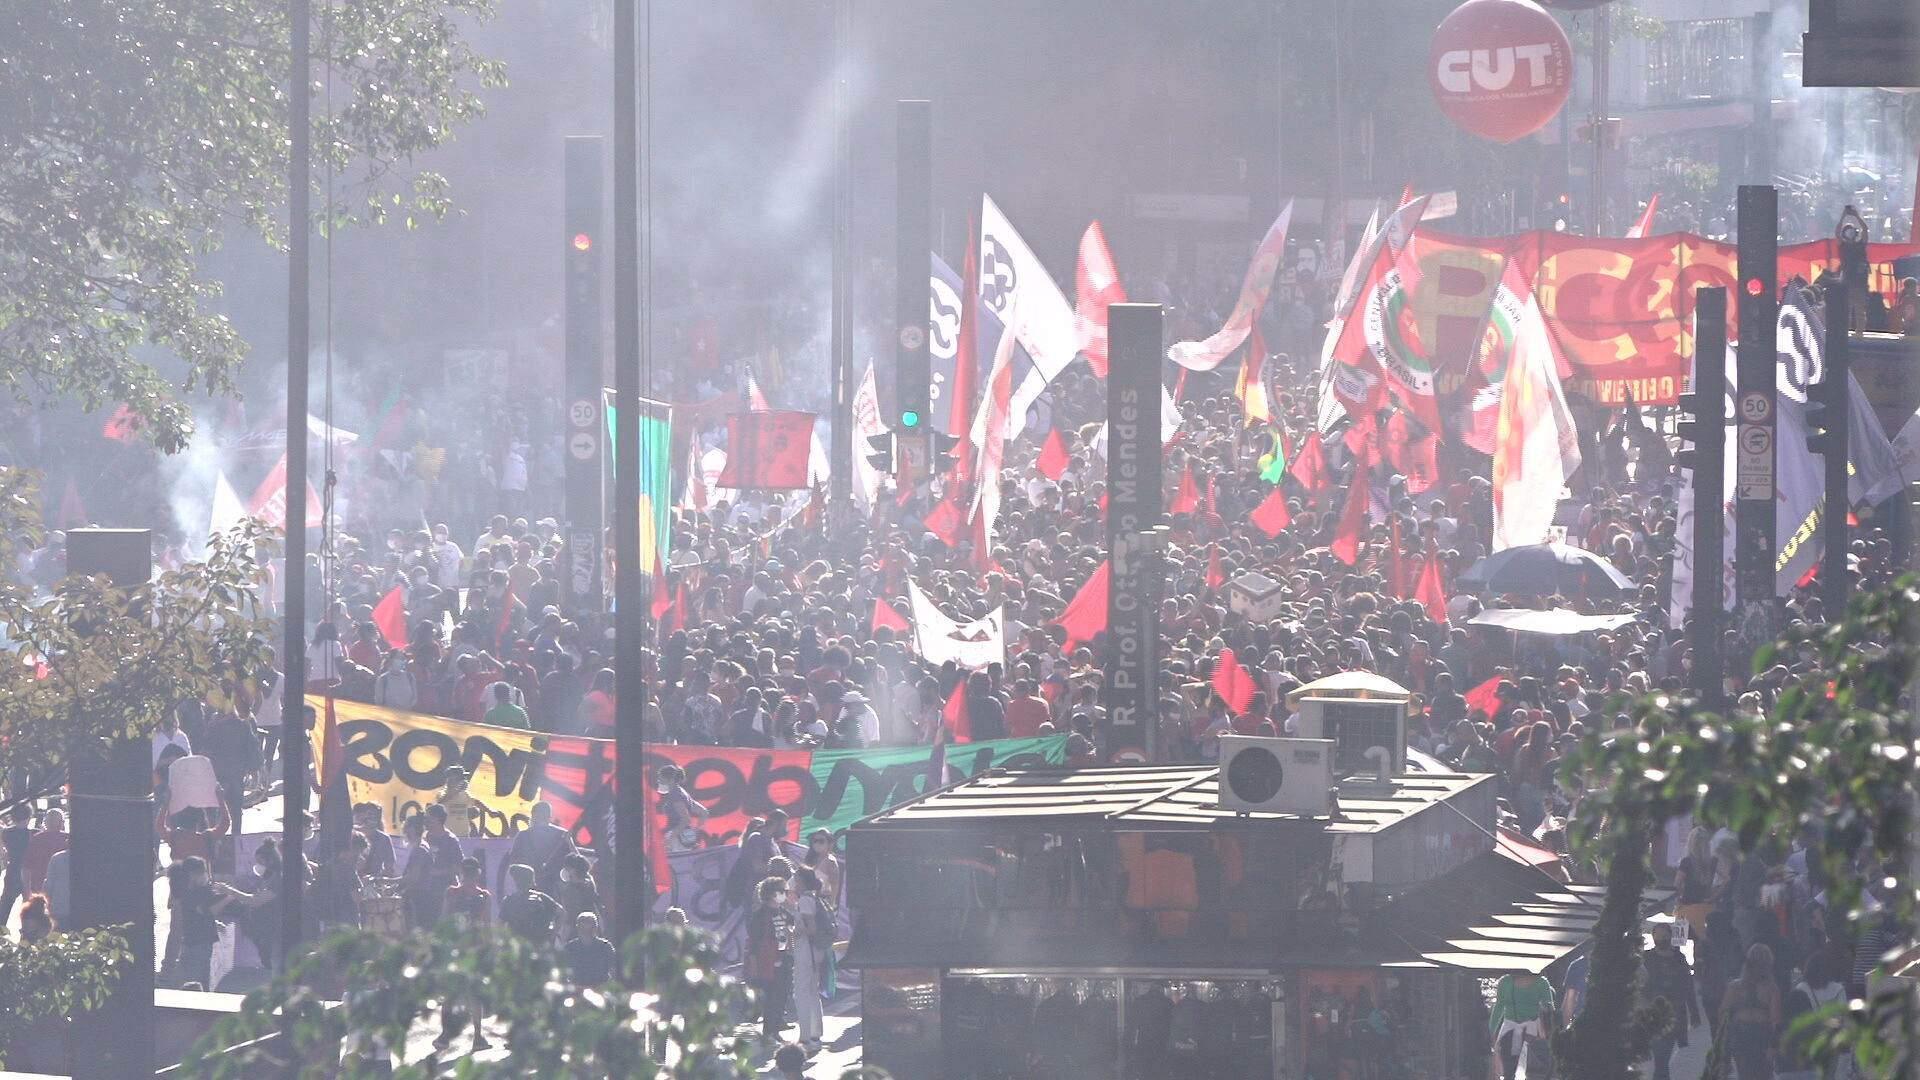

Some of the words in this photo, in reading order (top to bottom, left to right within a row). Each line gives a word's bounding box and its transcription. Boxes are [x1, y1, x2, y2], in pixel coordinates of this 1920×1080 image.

[1438, 44, 1552, 93] CUT
[573, 406, 592, 419] 50
[1745, 399, 1766, 413] 50
[1113, 389, 1137, 503] Mendes
[1113, 621, 1137, 689] Prof.
[1113, 700, 1137, 726] R.
